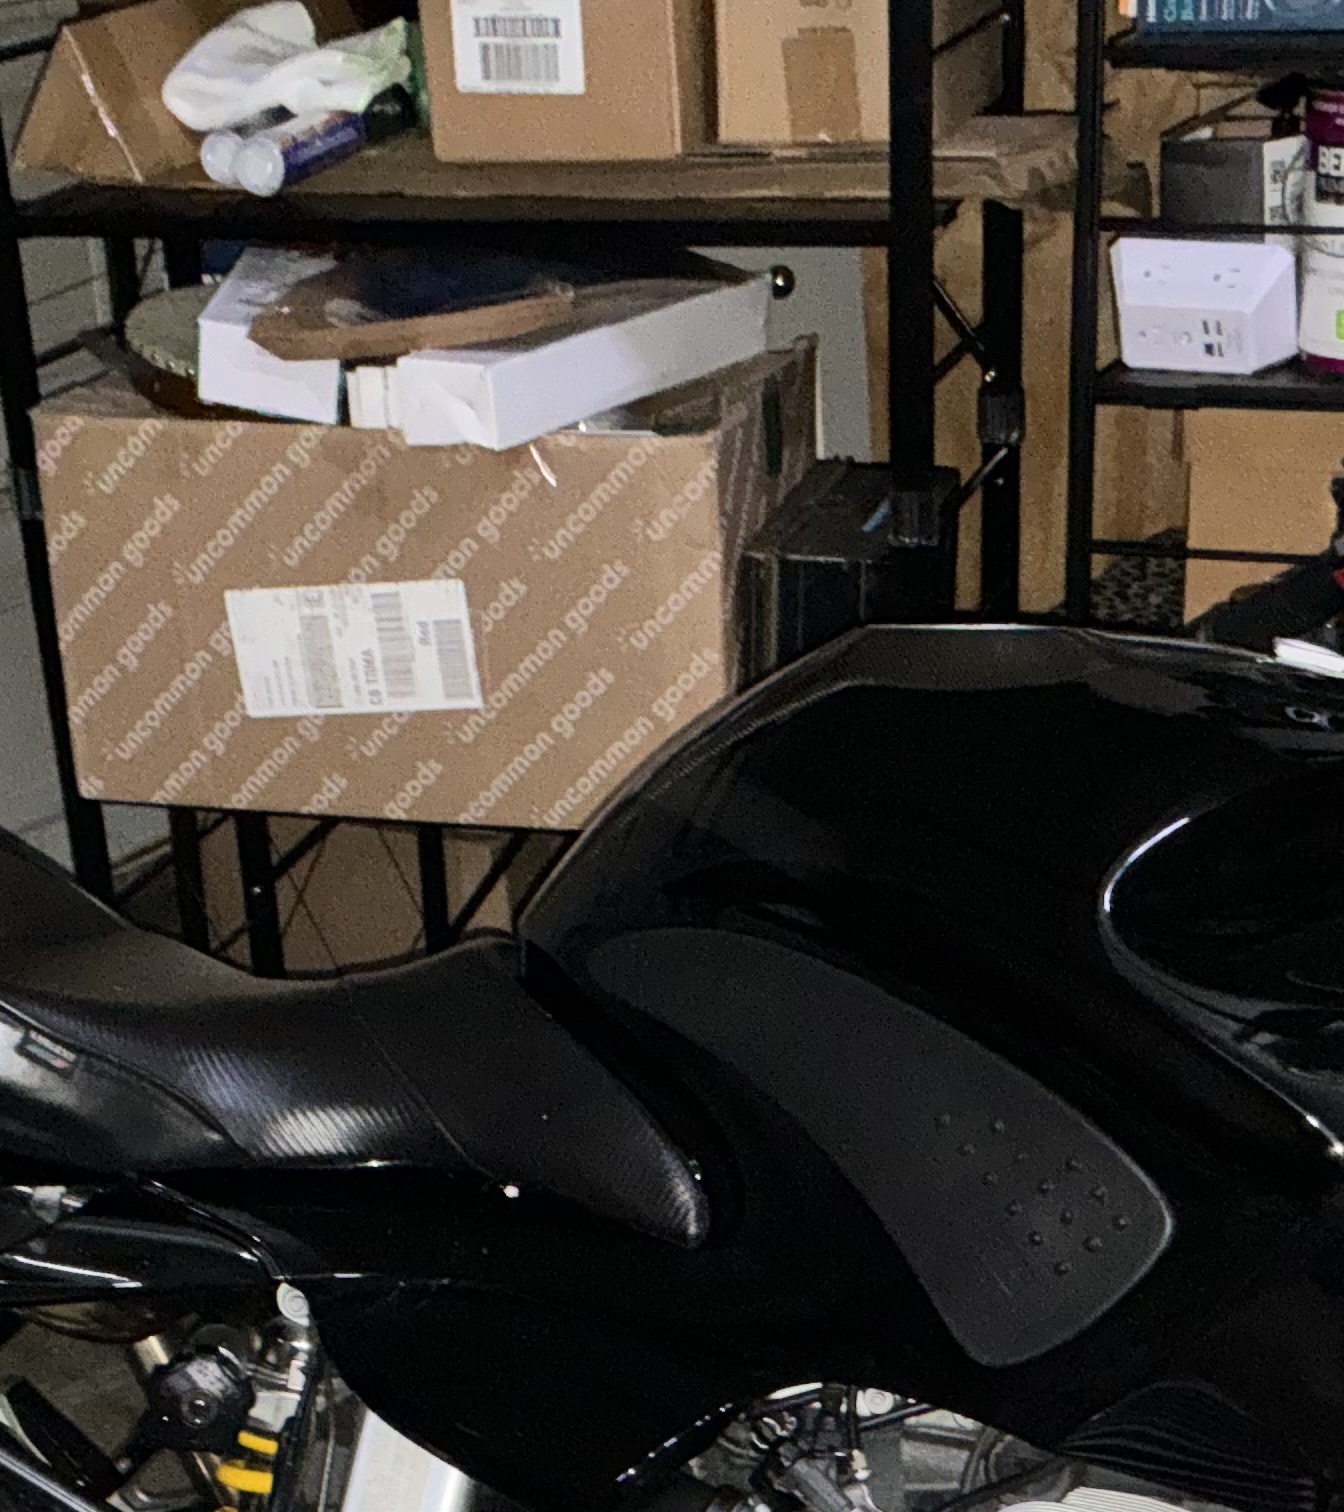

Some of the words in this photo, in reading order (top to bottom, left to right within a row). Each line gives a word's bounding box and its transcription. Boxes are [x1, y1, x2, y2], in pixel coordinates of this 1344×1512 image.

[122, 493, 182, 568] goods
[185, 462, 293, 586] uncommon
[282, 445, 391, 570] uncommon
[375, 486, 440, 563] goods
[476, 466, 543, 544] goods
[116, 601, 174, 673] goods
[455, 628, 568, 744] uncommon
[563, 560, 631, 634] goods
[115, 649, 213, 761] uncommon
[542, 715, 656, 829] uncommon
[651, 647, 720, 723] goods
[550, 666, 615, 740] goods
